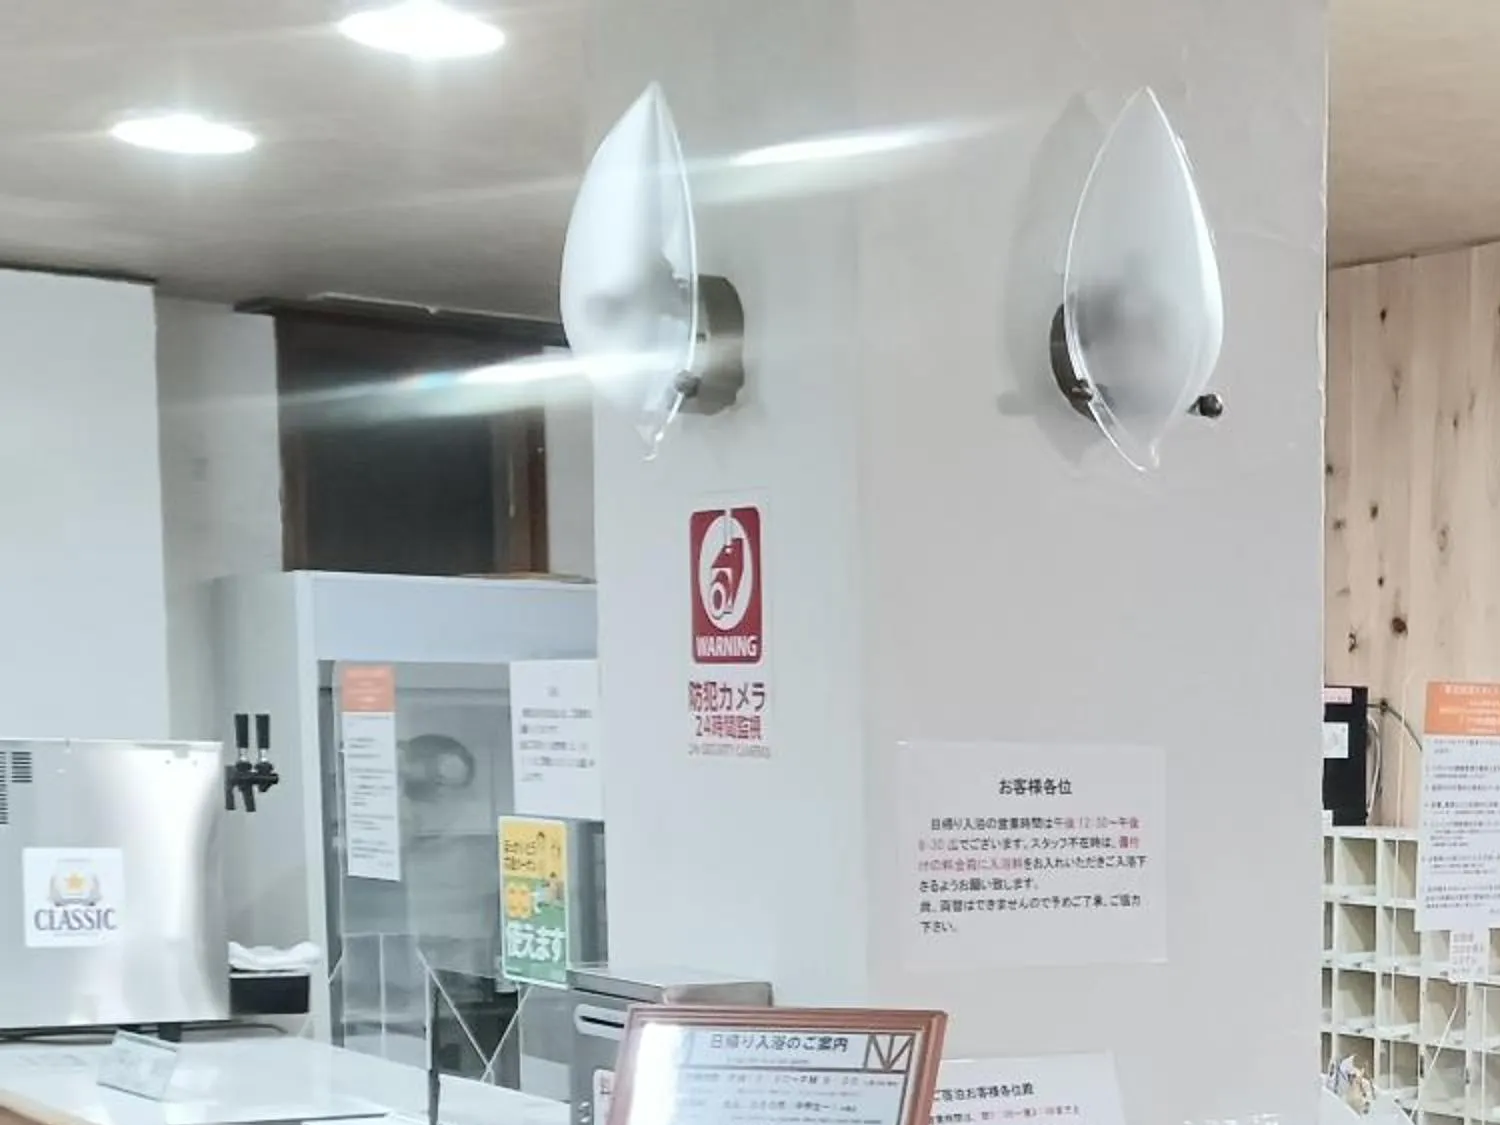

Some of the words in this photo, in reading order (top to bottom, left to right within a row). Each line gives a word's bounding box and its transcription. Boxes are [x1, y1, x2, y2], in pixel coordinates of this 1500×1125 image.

[696, 635, 757, 657] WARNING
[688, 681, 765, 712] 防犯カメラ
[999, 777, 1073, 796] お客様各位
[33, 908, 118, 931] CLASSIC
[710, 1034, 849, 1053] 日帰り入浴のご案内
